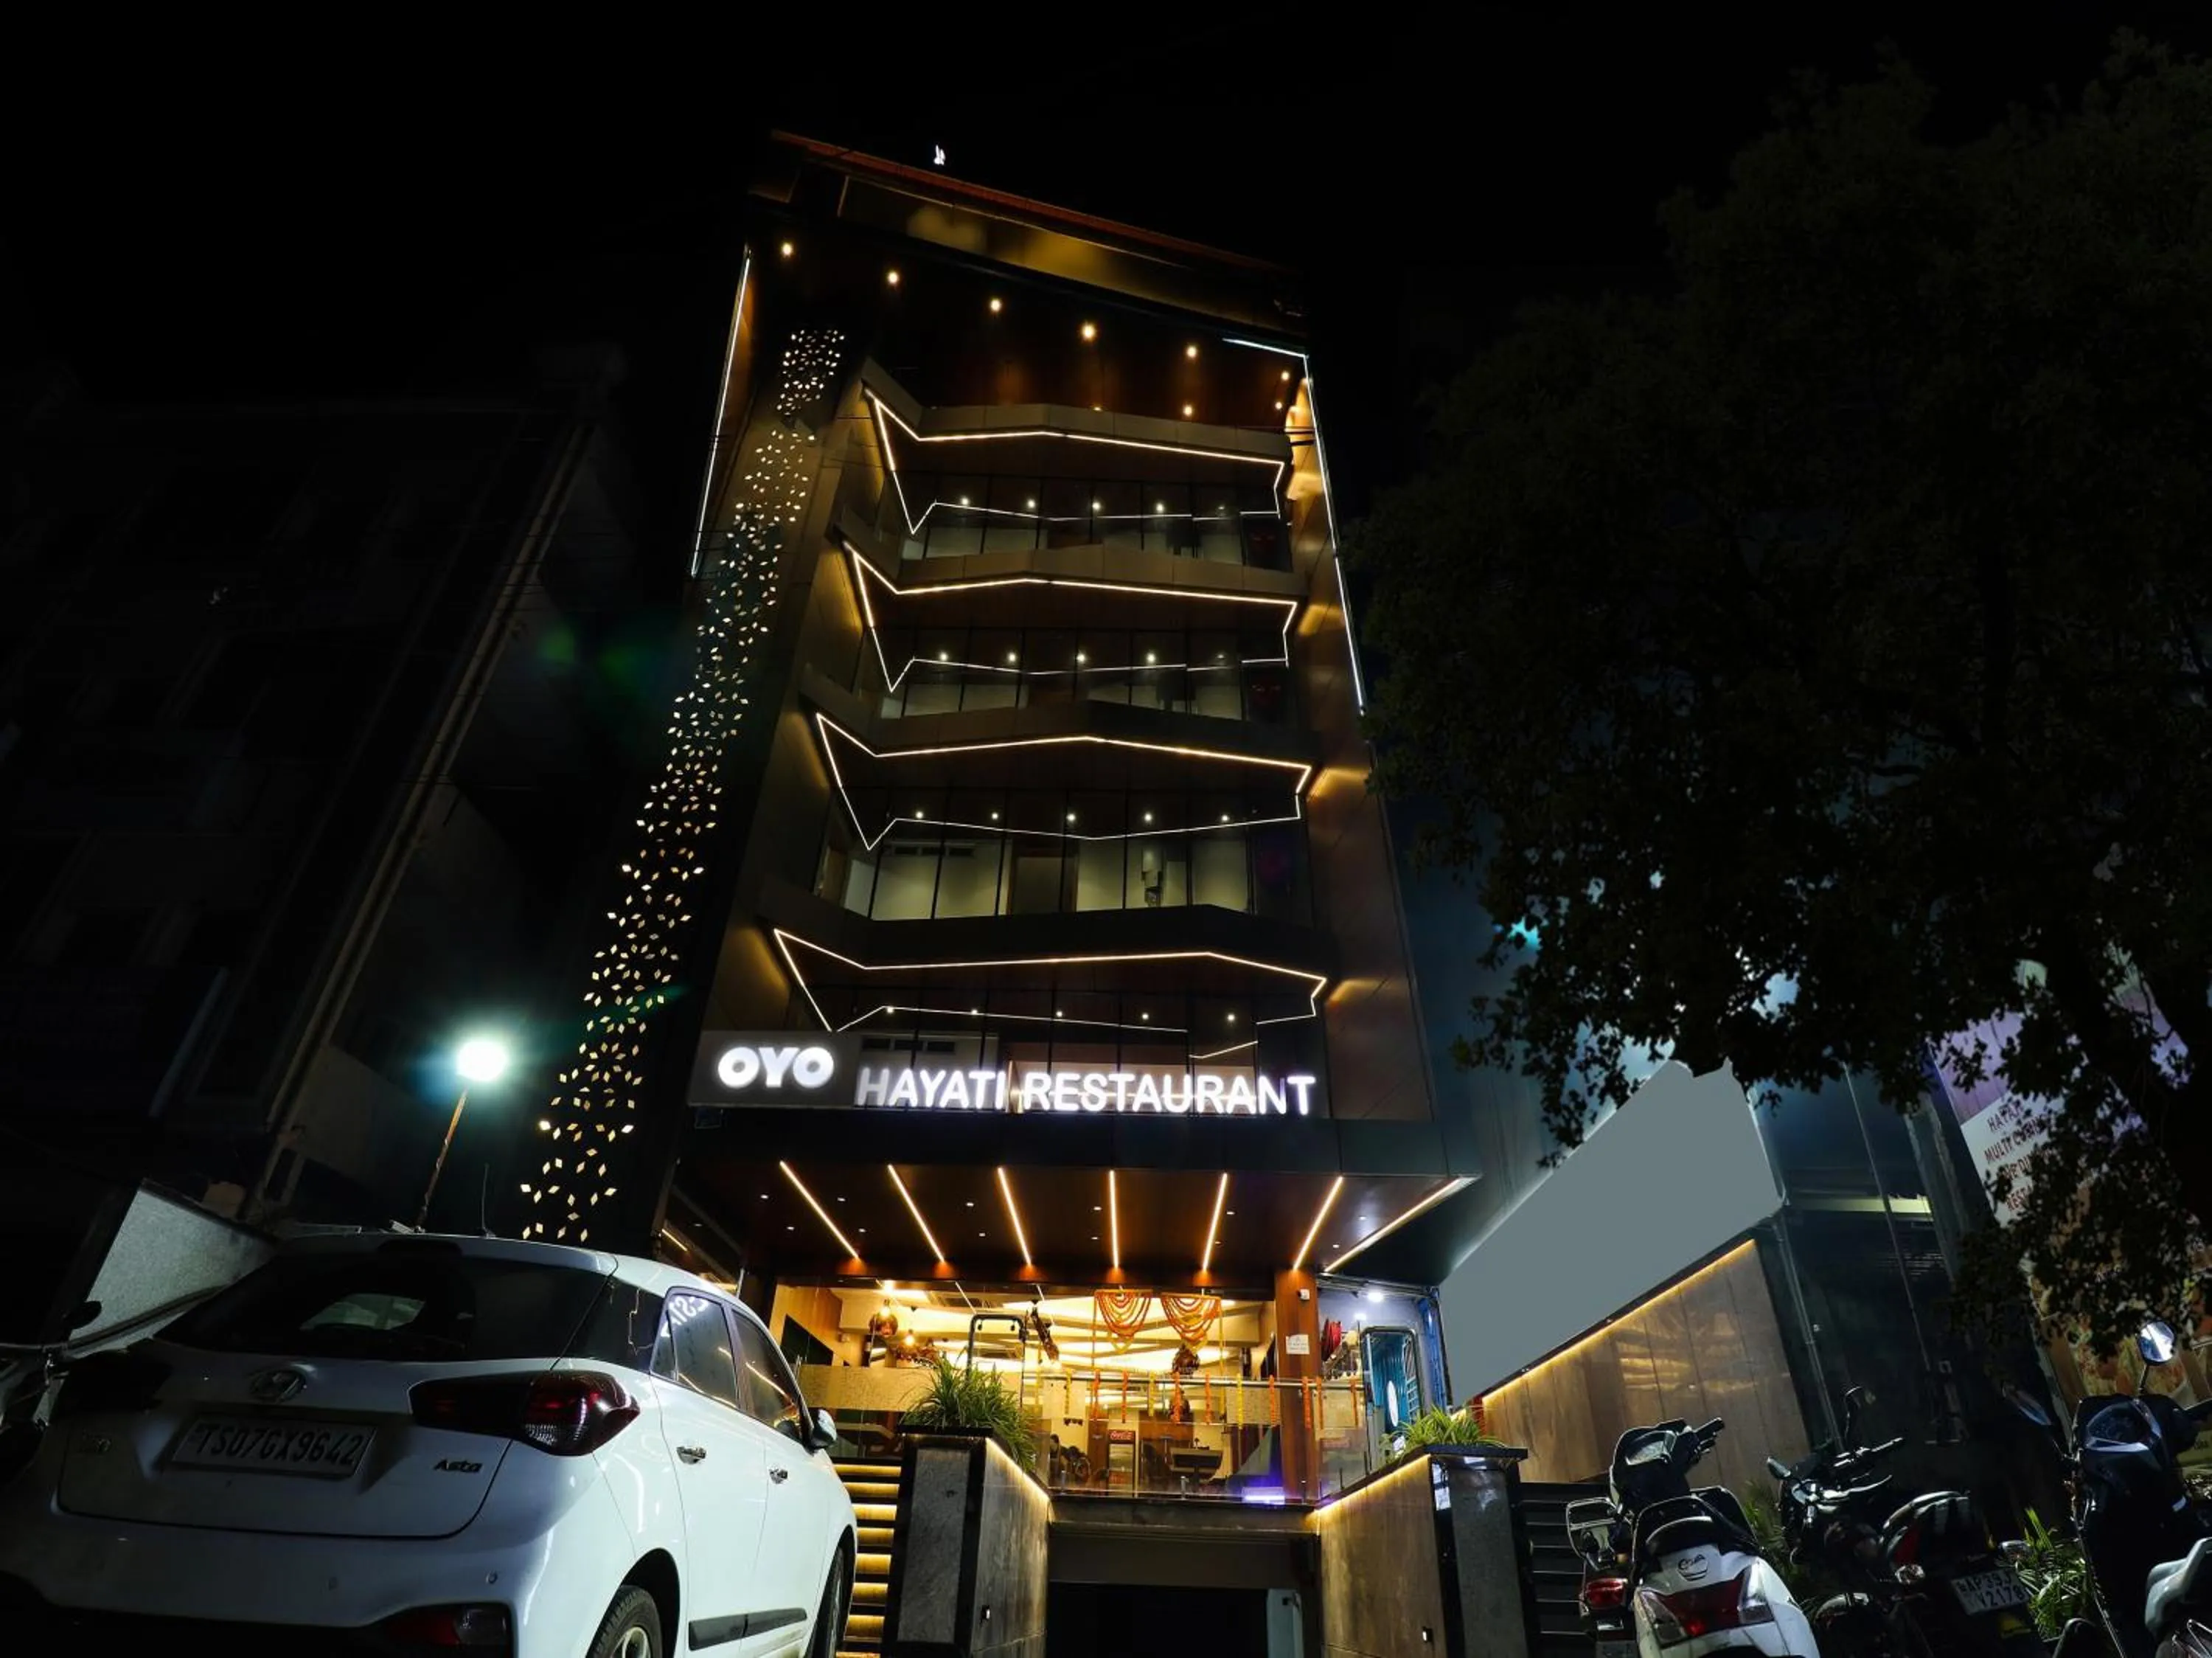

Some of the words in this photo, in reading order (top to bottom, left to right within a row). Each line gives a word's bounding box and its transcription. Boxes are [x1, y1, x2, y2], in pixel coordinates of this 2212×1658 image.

[718, 1047, 834, 1088] OYO
[858, 1067, 1006, 1109] HAYATI
[1023, 1072, 1317, 1115] RESTAURANT
[195, 1423, 363, 1465] TS07GX9642
